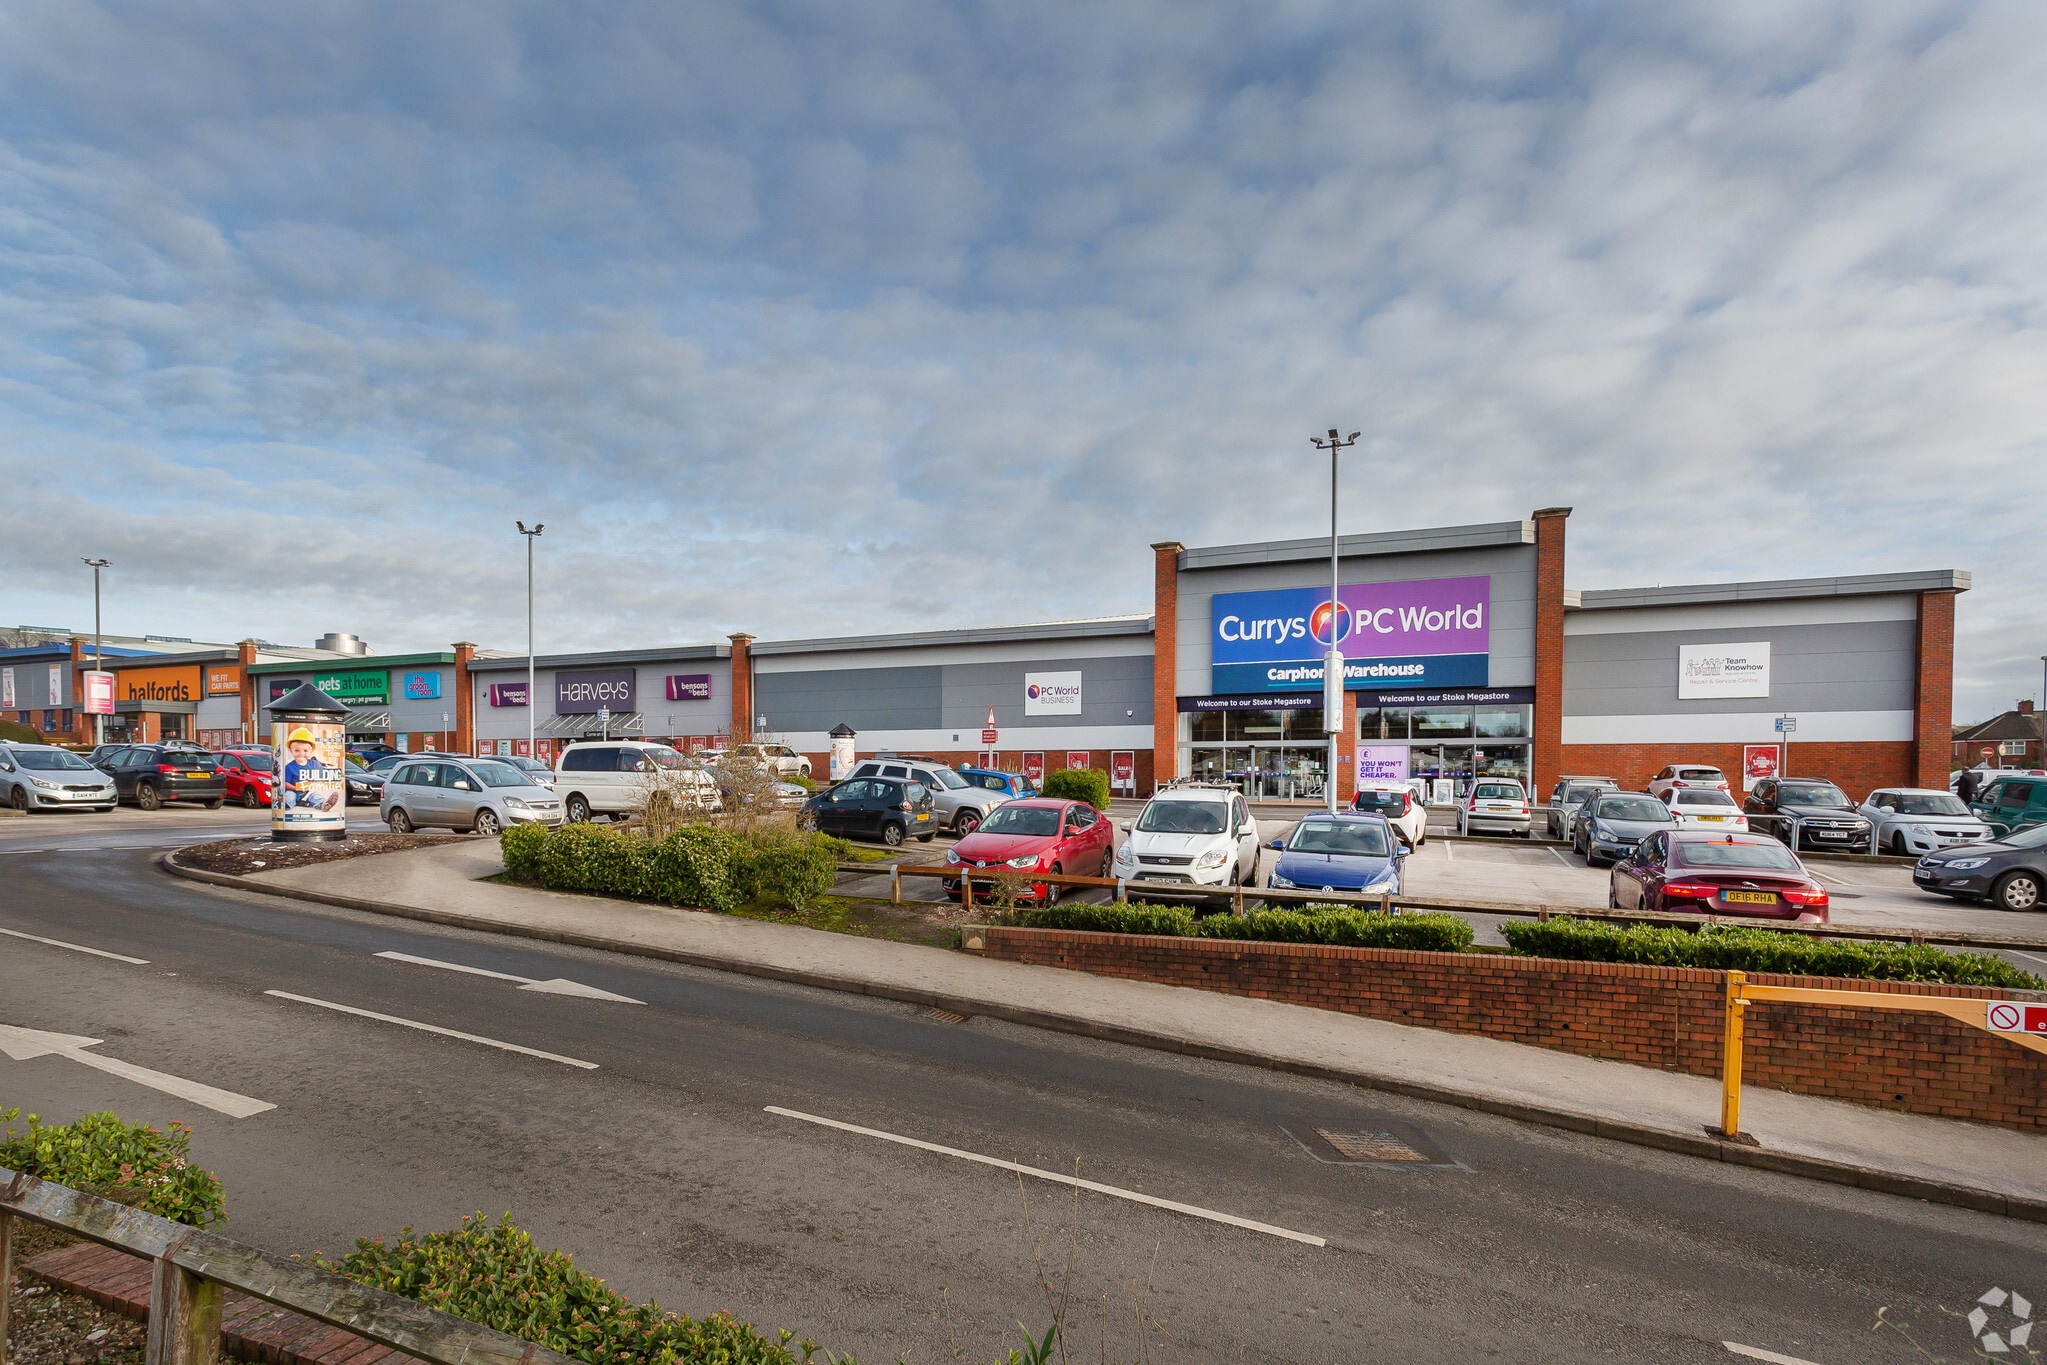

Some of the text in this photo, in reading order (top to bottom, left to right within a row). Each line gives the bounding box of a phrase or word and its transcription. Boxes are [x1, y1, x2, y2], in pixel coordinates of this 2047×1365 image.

[1218, 602, 1483, 645] Currys PC World
[1267, 667, 1324, 683] Carphon
[211, 682, 239, 690] CAR PARTS
[318, 674, 383, 691] pets at home
[681, 682, 708, 690] bensons
[129, 680, 189, 701] halfords
[503, 690, 526, 698] bensons
[692, 688, 708, 696] beds
[1041, 685, 1080, 696] PC World
[1040, 696, 1075, 704] BUSINESS
[1252, 698, 1273, 706] Stoke
[1274, 698, 1311, 707] Megastore
[1379, 695, 1415, 703] Welcome
[1442, 693, 1465, 701] Stoke
[1467, 692, 1510, 701] Megastore
[299, 769, 342, 781] BUILDING
[1729, 892, 1773, 903] OE16 RHA
